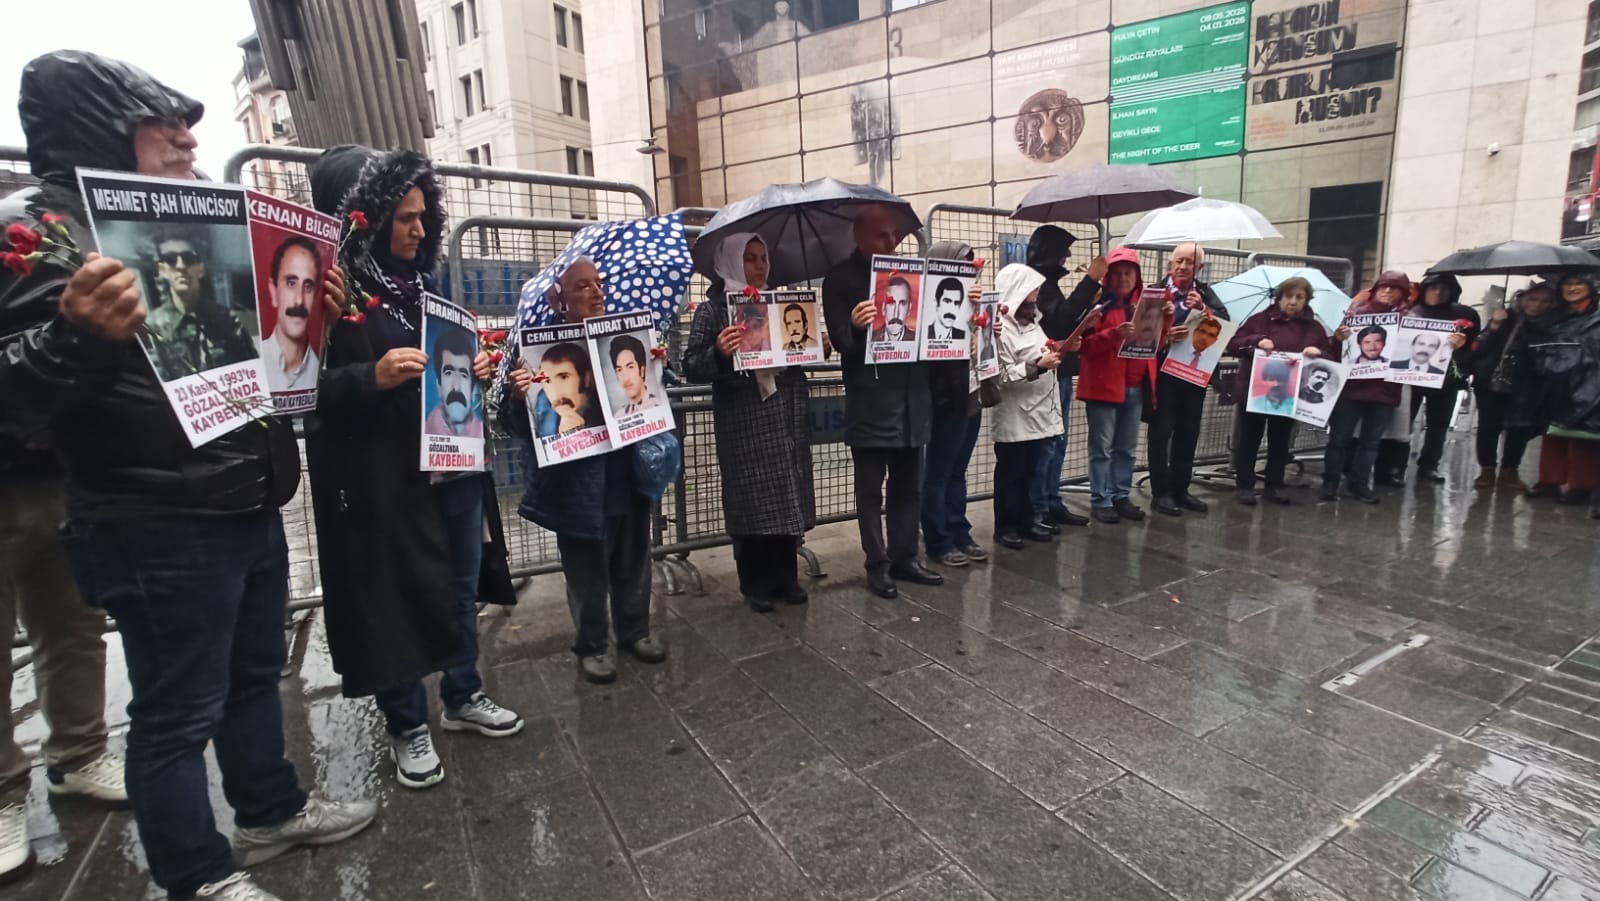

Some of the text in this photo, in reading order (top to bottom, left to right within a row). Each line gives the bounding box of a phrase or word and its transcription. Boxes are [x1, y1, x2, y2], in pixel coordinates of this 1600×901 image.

[1200, 7, 1246, 23] 09.05.2025
[1200, 16, 1245, 32] 04.01.2026
[1113, 71, 1158, 85] DAYDREAMS
[1135, 106, 1158, 117] SAYIN
[1140, 125, 1160, 136] GECE
[1112, 142, 1200, 160] THE NIGHT OF THE DEER
[93, 188, 239, 218] MEHMET ŞAH İKİNCİSOY
[247, 196, 340, 241] KENAN BİLGİN
[426, 297, 461, 326] İBRAHİM
[588, 314, 652, 336] MURAT YILDIZ
[1345, 314, 1397, 327] HASAN OCAK
[527, 331, 556, 343] CEMİL
[874, 349, 911, 361] KAYBEDİLDİ
[927, 349, 964, 358] KAYBEDİLDİ
[174, 387, 188, 402] 23
[219, 367, 257, 386] 1993'te
[620, 417, 667, 442] KAYBEDİLDİ
[429, 452, 475, 467] KAYBEDİLDİ
